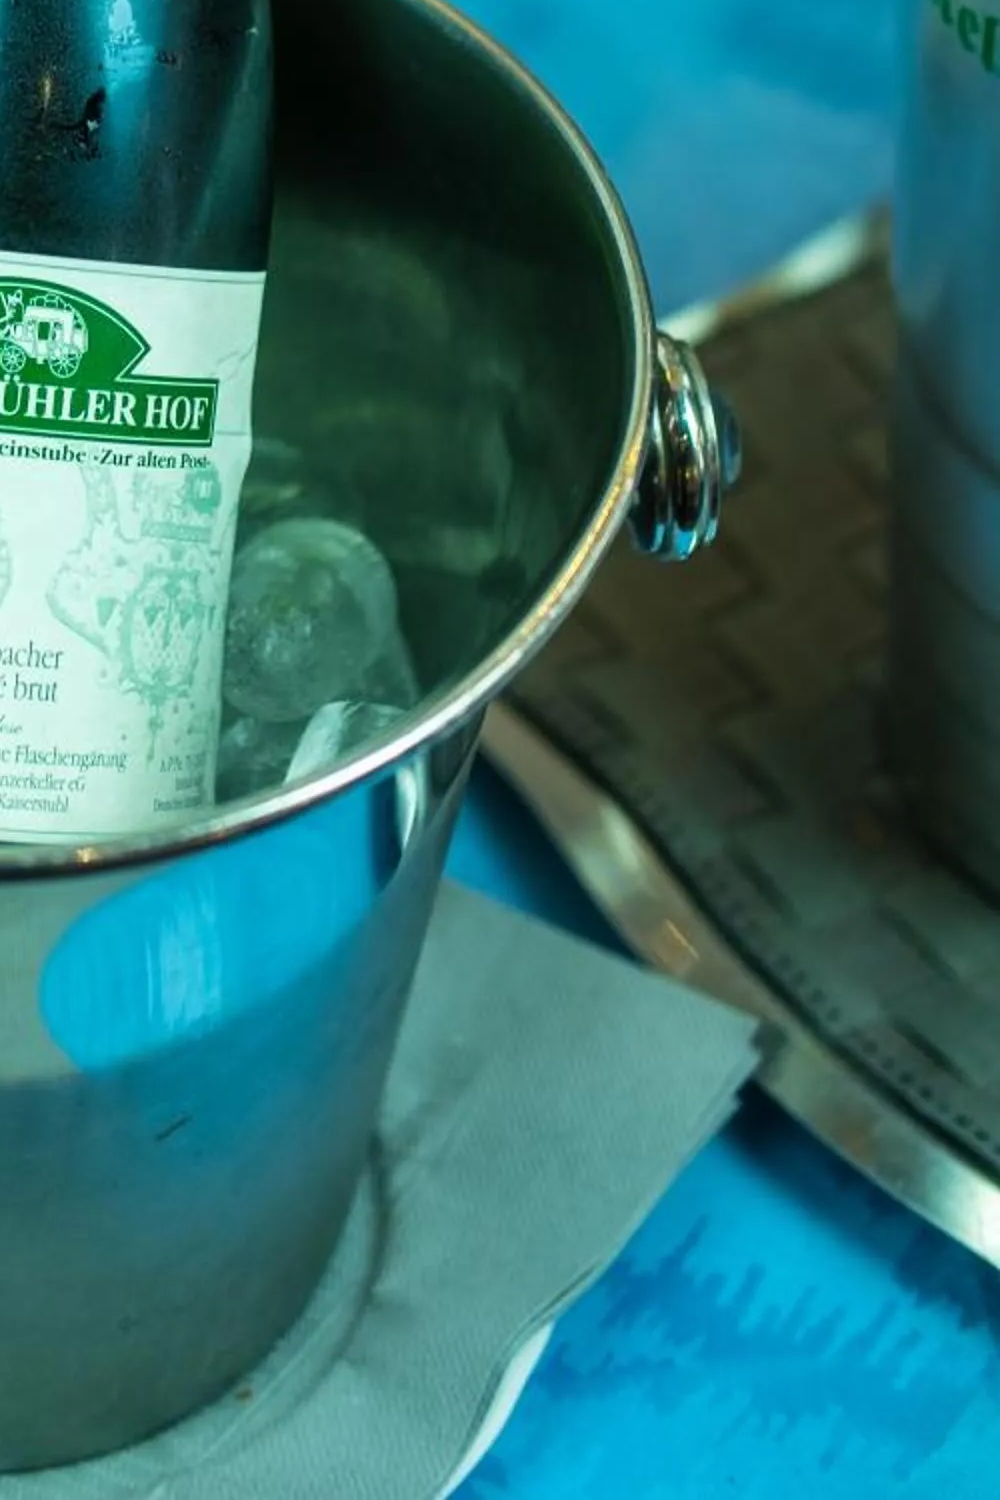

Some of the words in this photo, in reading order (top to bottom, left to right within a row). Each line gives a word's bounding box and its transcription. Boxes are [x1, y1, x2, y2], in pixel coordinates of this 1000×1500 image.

[143, 394, 209, 431] HOF
[137, 451, 176, 469] alten
[13, 673, 58, 703] brut
[15, 744, 128, 774] Flaschengärung
